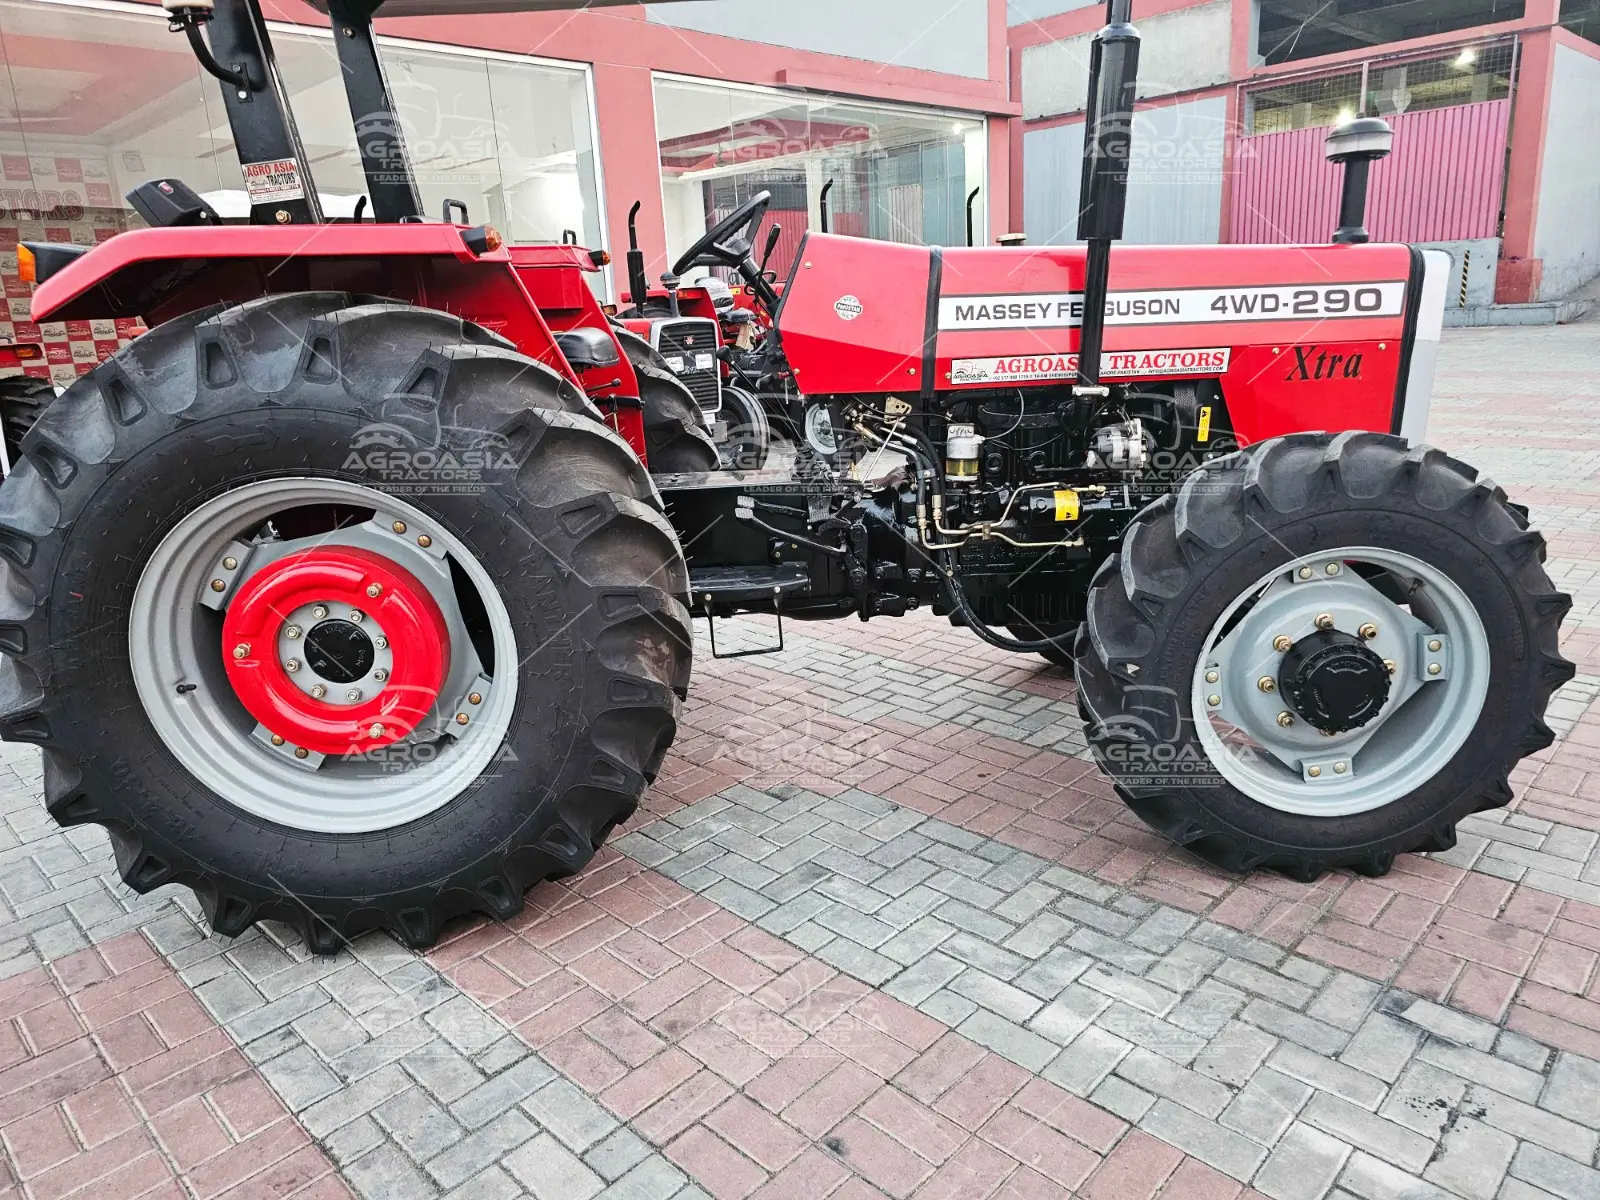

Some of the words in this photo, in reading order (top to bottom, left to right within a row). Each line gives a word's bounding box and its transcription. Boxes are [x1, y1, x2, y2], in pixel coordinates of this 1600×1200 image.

[247, 164, 271, 177] AGRO
[273, 161, 296, 174] ASIA
[266, 171, 296, 187] TRACTORS
[0, 188, 85, 221] TORS
[955, 302, 1052, 321] MASSEY
[1056, 298, 1181, 318] FEGUSON
[1210, 288, 1382, 314] 4WD-290
[1109, 351, 1224, 370] TRACTORS
[1284, 345, 1363, 381] Xtra
